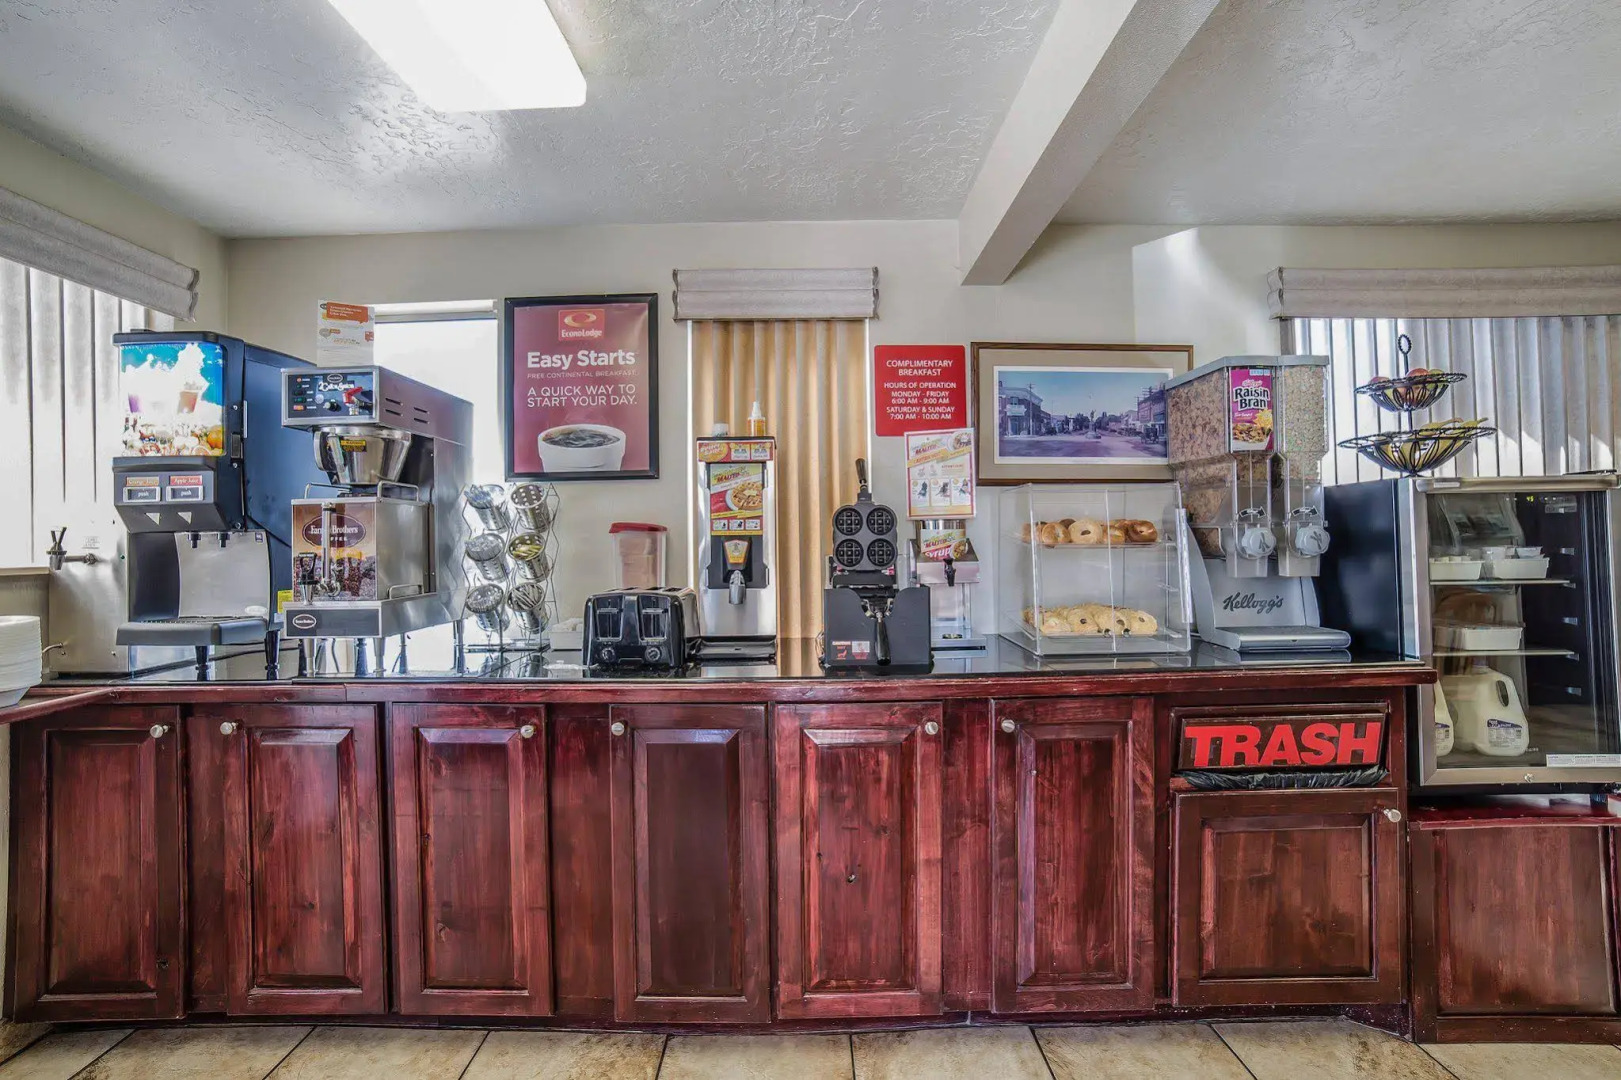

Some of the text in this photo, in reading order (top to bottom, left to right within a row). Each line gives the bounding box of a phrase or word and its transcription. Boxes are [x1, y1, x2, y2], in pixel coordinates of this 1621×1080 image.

[527, 350, 636, 370] Easy Starts
[886, 360, 953, 368] COMPLIMENTARY
[898, 368, 942, 376] BREAKFAST
[527, 384, 636, 397] A QUICK WAY TO
[1234, 387, 1269, 400] Raisin
[527, 395, 637, 407] START YOUR DAY.
[1239, 398, 1266, 409] Bran
[332, 524, 358, 534] Brothers
[1223, 592, 1284, 614] Kellogg's
[1185, 722, 1381, 767] TRASH
